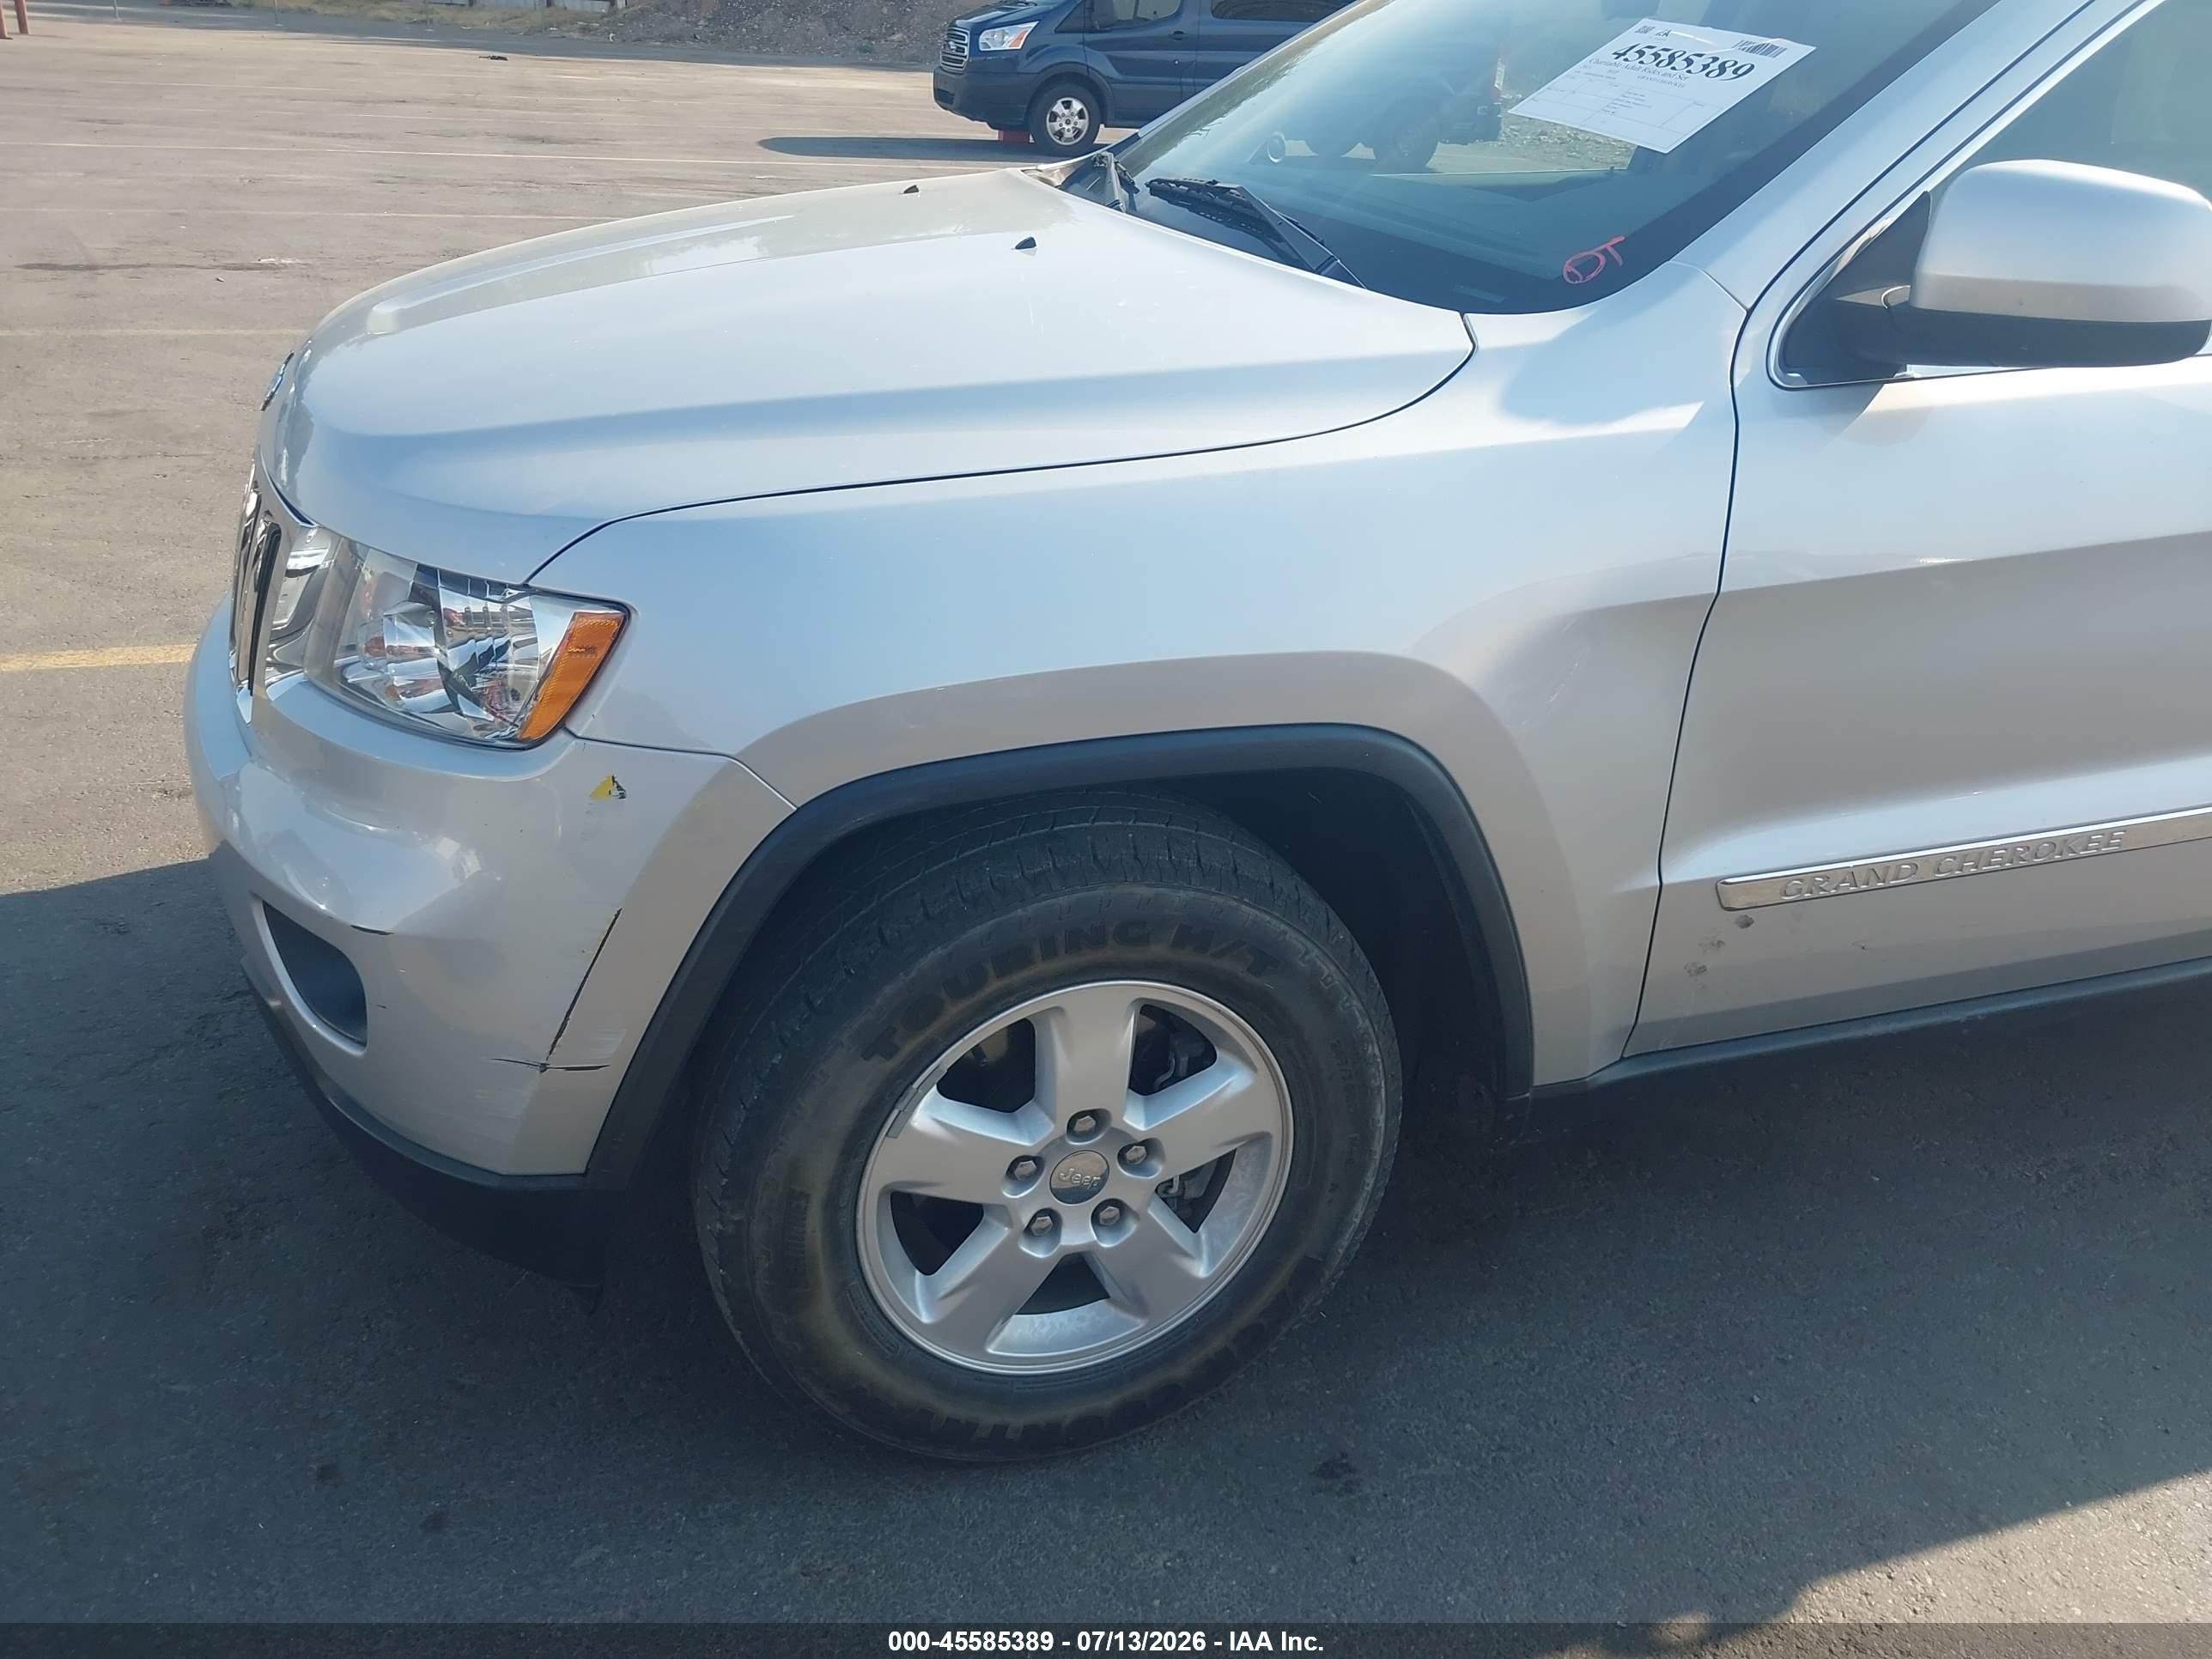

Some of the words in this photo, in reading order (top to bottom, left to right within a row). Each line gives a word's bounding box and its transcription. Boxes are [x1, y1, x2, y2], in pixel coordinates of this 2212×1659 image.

[1612, 42, 1755, 82] 45585389
[1778, 861, 1920, 901] GRAND
[1932, 830, 2128, 878] CHEROKEE
[861, 920, 1152, 1061] TOURING
[1059, 1167, 1102, 1190] Jeep
